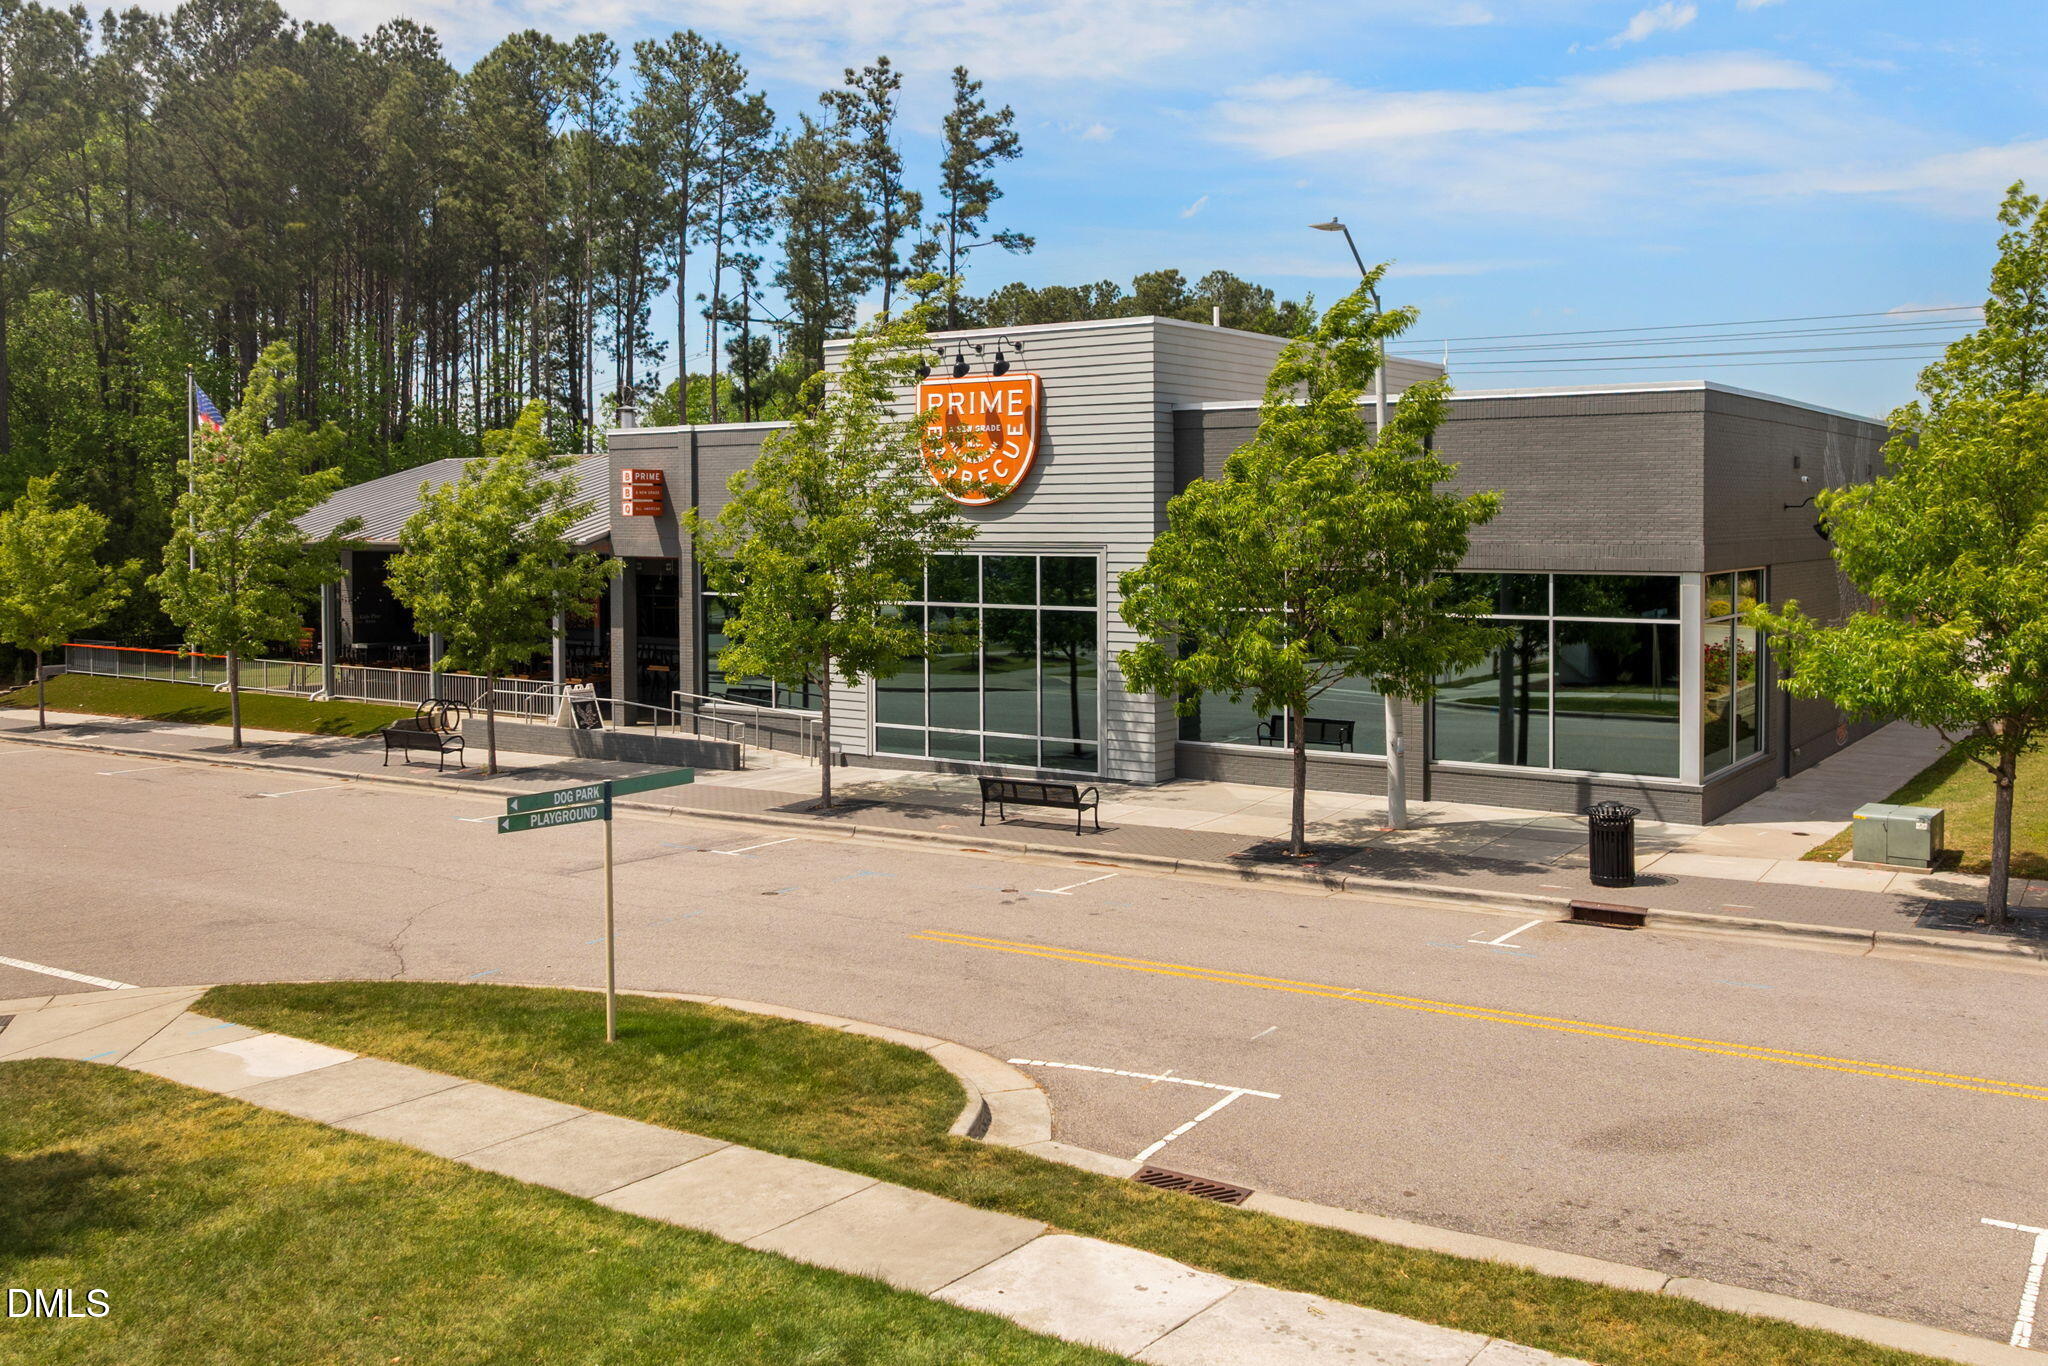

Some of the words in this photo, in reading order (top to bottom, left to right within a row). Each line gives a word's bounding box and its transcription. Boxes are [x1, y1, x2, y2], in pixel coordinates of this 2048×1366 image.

[927, 389, 1024, 416] PRIME
[975, 424, 1001, 432] GRADE
[635, 472, 660, 480] PRIME
[553, 791, 574, 805] DOG
[575, 786, 600, 801] PARK
[530, 806, 598, 827] PLAYGROUND
